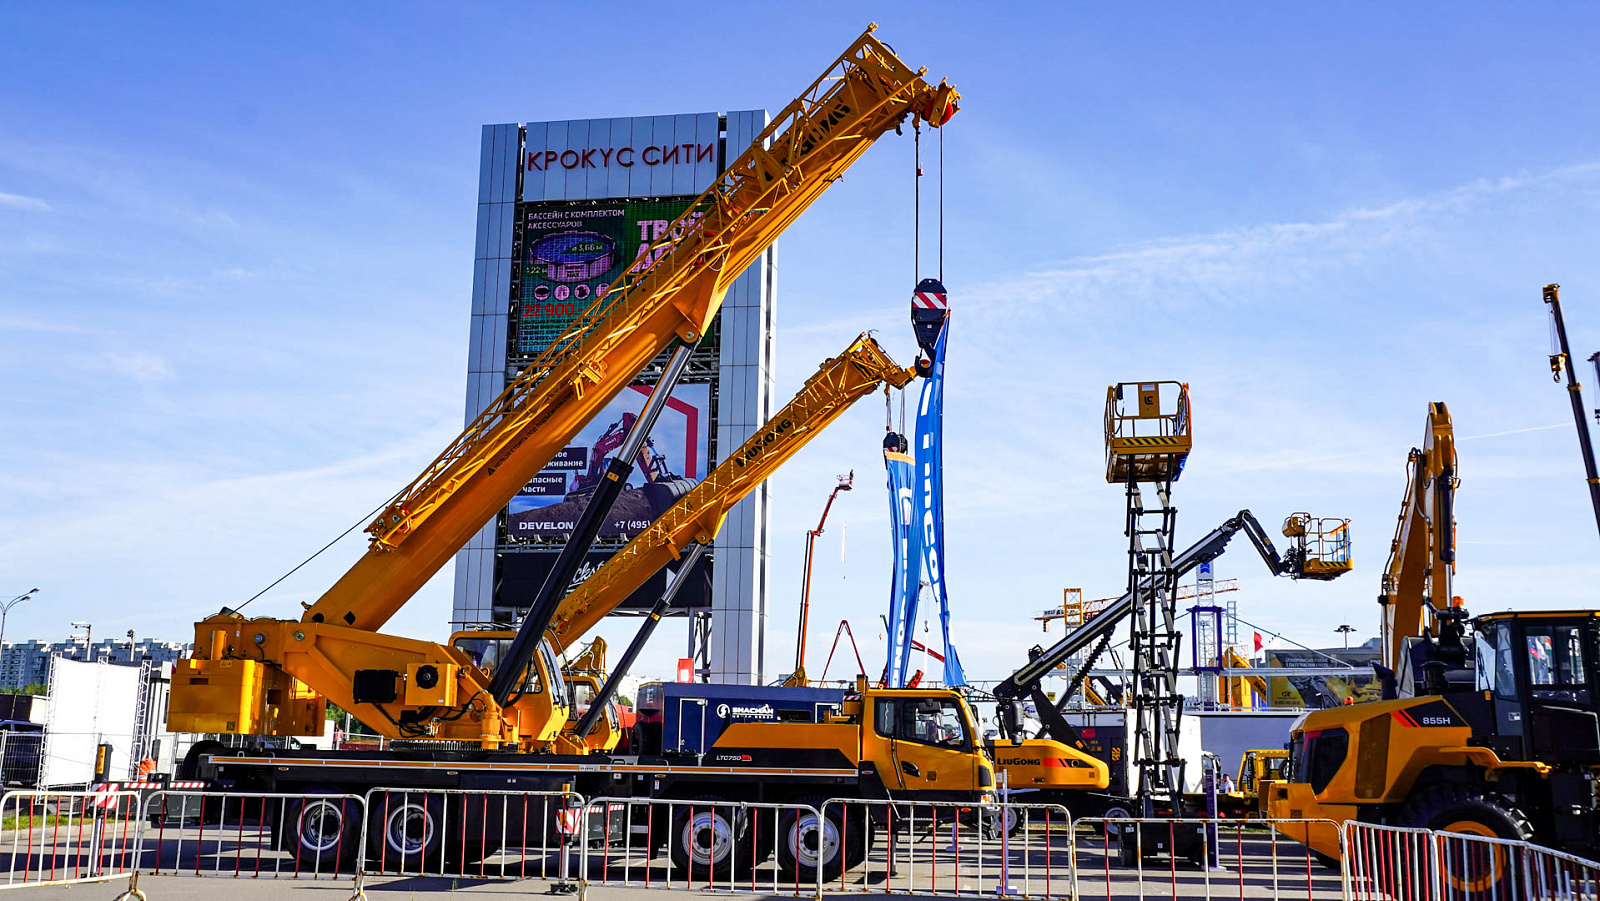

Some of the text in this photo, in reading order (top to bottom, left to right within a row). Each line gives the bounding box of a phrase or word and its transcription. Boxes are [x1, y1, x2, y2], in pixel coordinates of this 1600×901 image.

[527, 142, 713, 171] КРОКУС СИТИ
[528, 209, 625, 220] БАССЕЙН С КОМПЛЕКТОМ
[527, 221, 583, 229] АКСЕССУАРОВ
[522, 304, 542, 317] 22
[519, 521, 574, 530] DEVELON
[614, 520, 625, 529] +7
[1422, 716, 1451, 725] 855H
